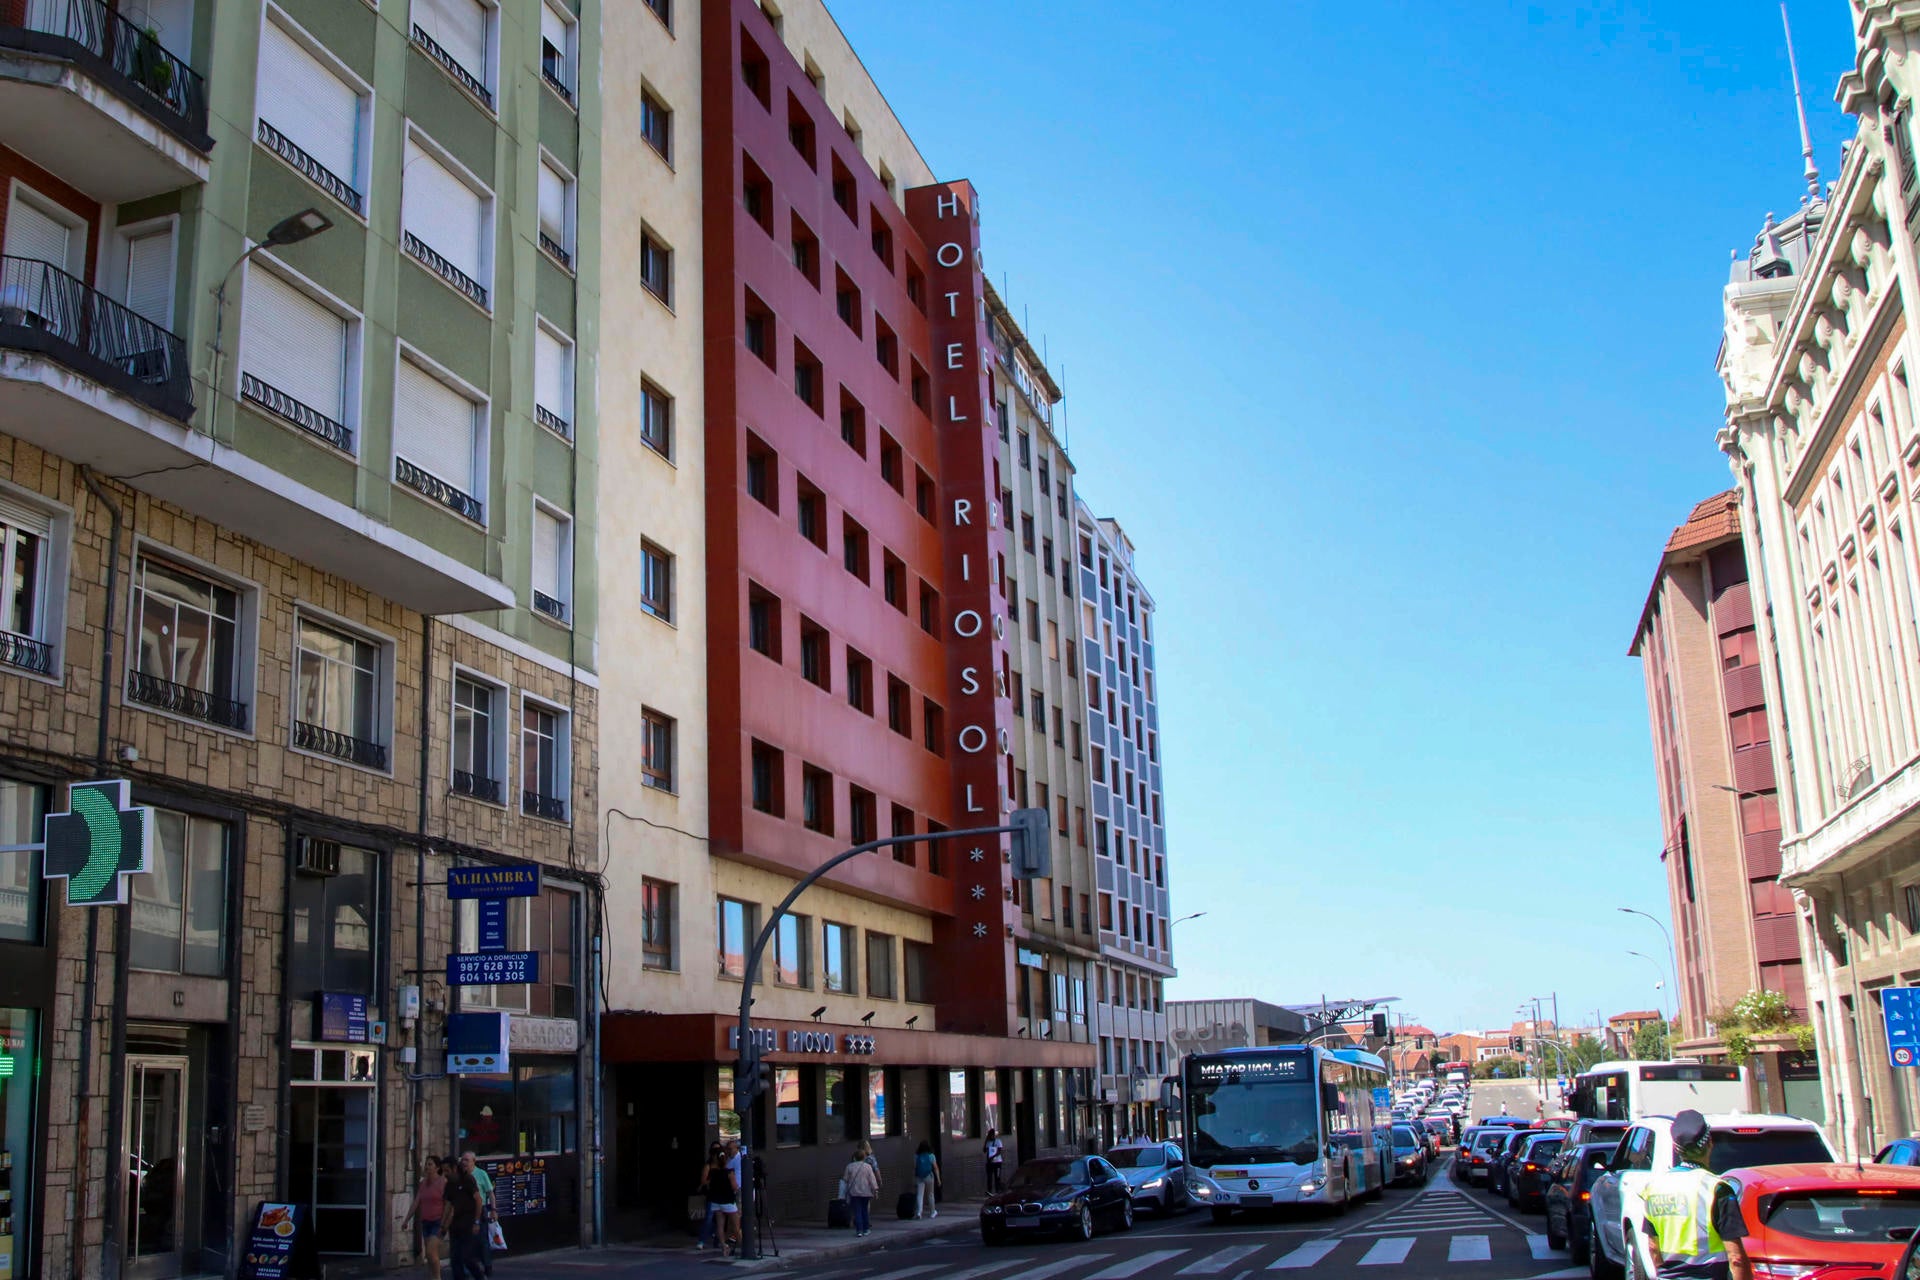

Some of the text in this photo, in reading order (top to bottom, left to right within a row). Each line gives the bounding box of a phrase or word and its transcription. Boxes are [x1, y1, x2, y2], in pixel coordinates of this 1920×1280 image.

[936, 192, 968, 422] HOTEL
[954, 499, 987, 813] RIOSOL
[453, 870, 534, 886] ALHAMBRA
[494, 953, 529, 961] DOMICILIO
[460, 960, 525, 972] 987 628 312
[459, 971, 525, 982] 604 145 305
